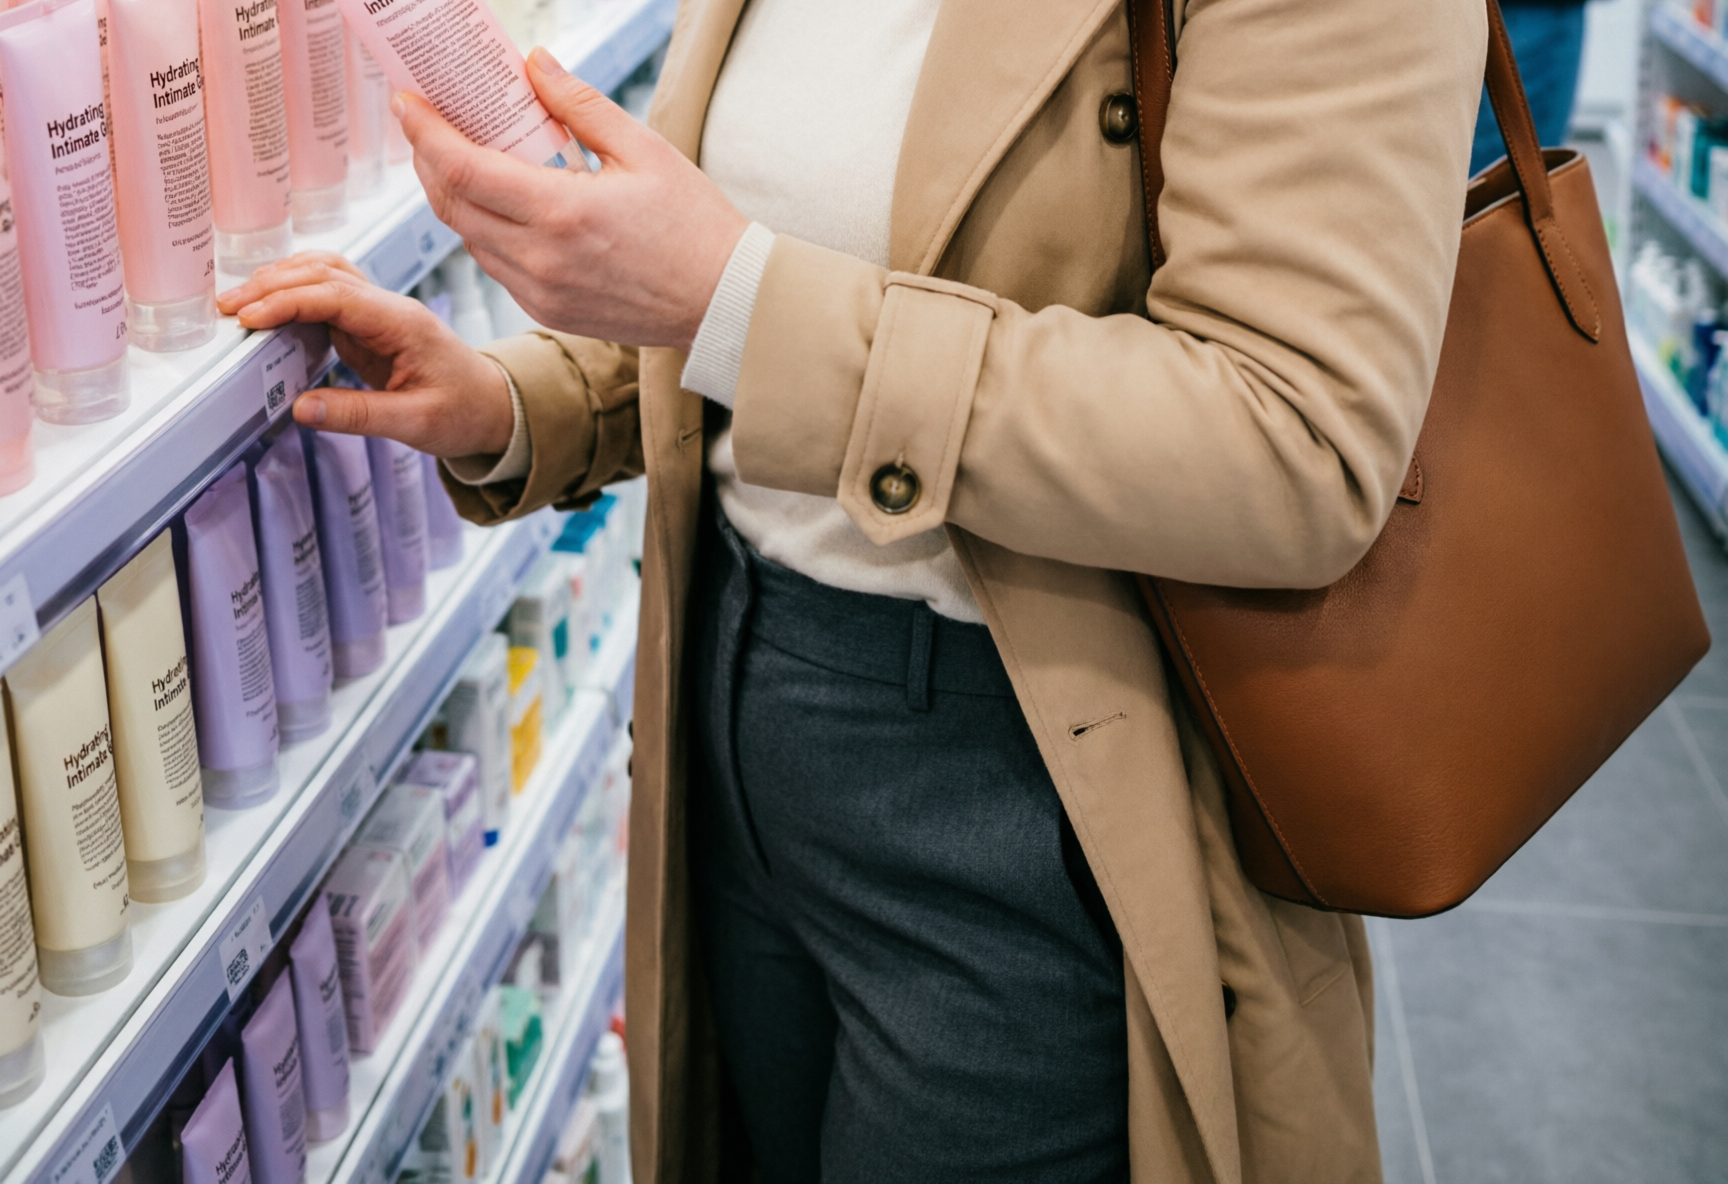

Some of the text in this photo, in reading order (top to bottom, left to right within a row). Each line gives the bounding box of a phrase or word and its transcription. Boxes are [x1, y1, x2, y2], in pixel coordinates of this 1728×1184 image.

[153, 81, 197, 109] Intimate
[46, 102, 105, 139] Hydrating
[51, 128, 101, 160] Intimate
[66, 748, 108, 790] Intimate
